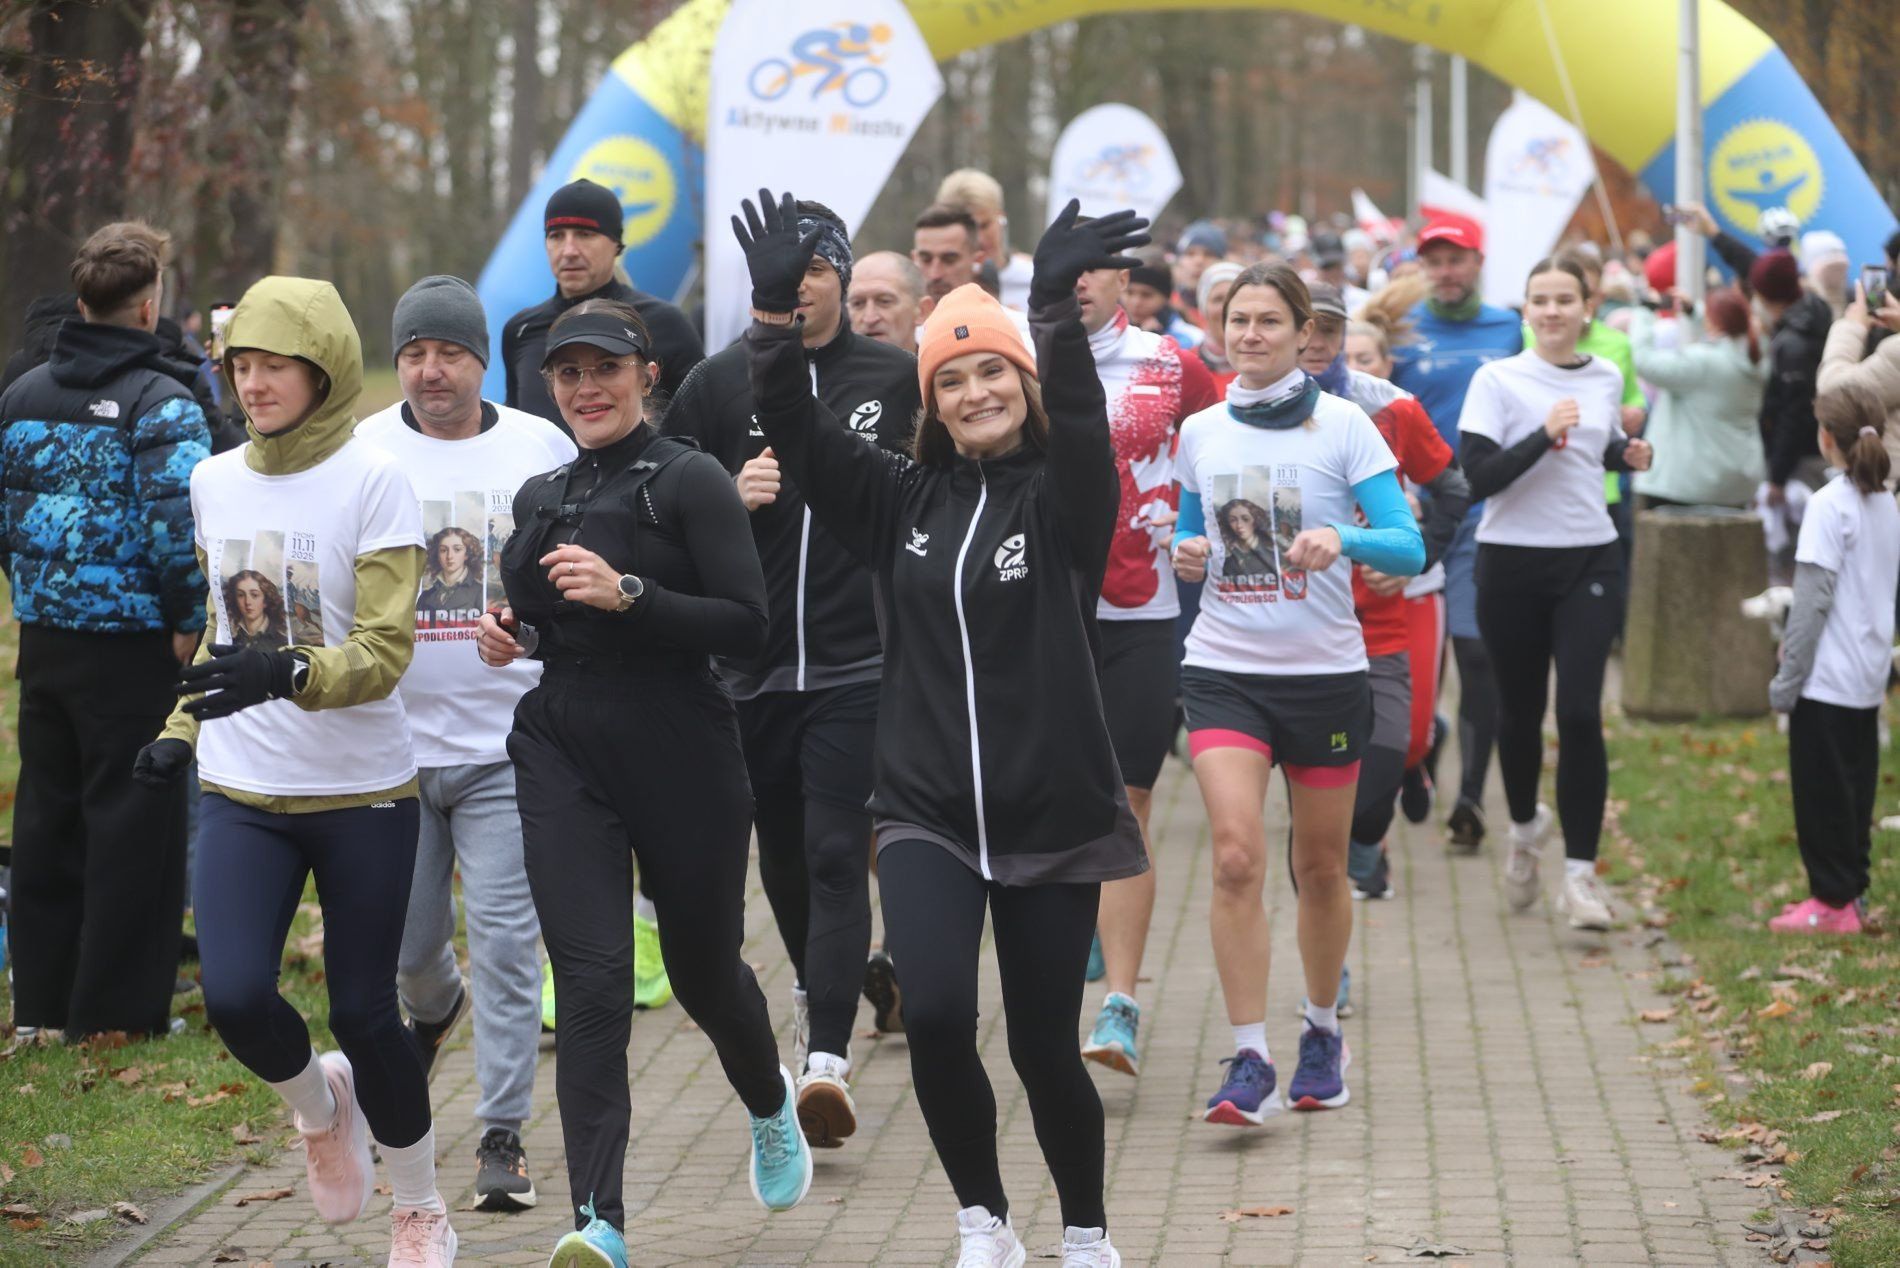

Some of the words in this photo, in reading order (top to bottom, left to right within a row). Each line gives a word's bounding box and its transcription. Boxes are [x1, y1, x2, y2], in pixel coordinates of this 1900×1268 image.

[292, 538, 315, 552] 11.11
[291, 550, 315, 560] 2025
[999, 566, 1029, 582] ZPRP
